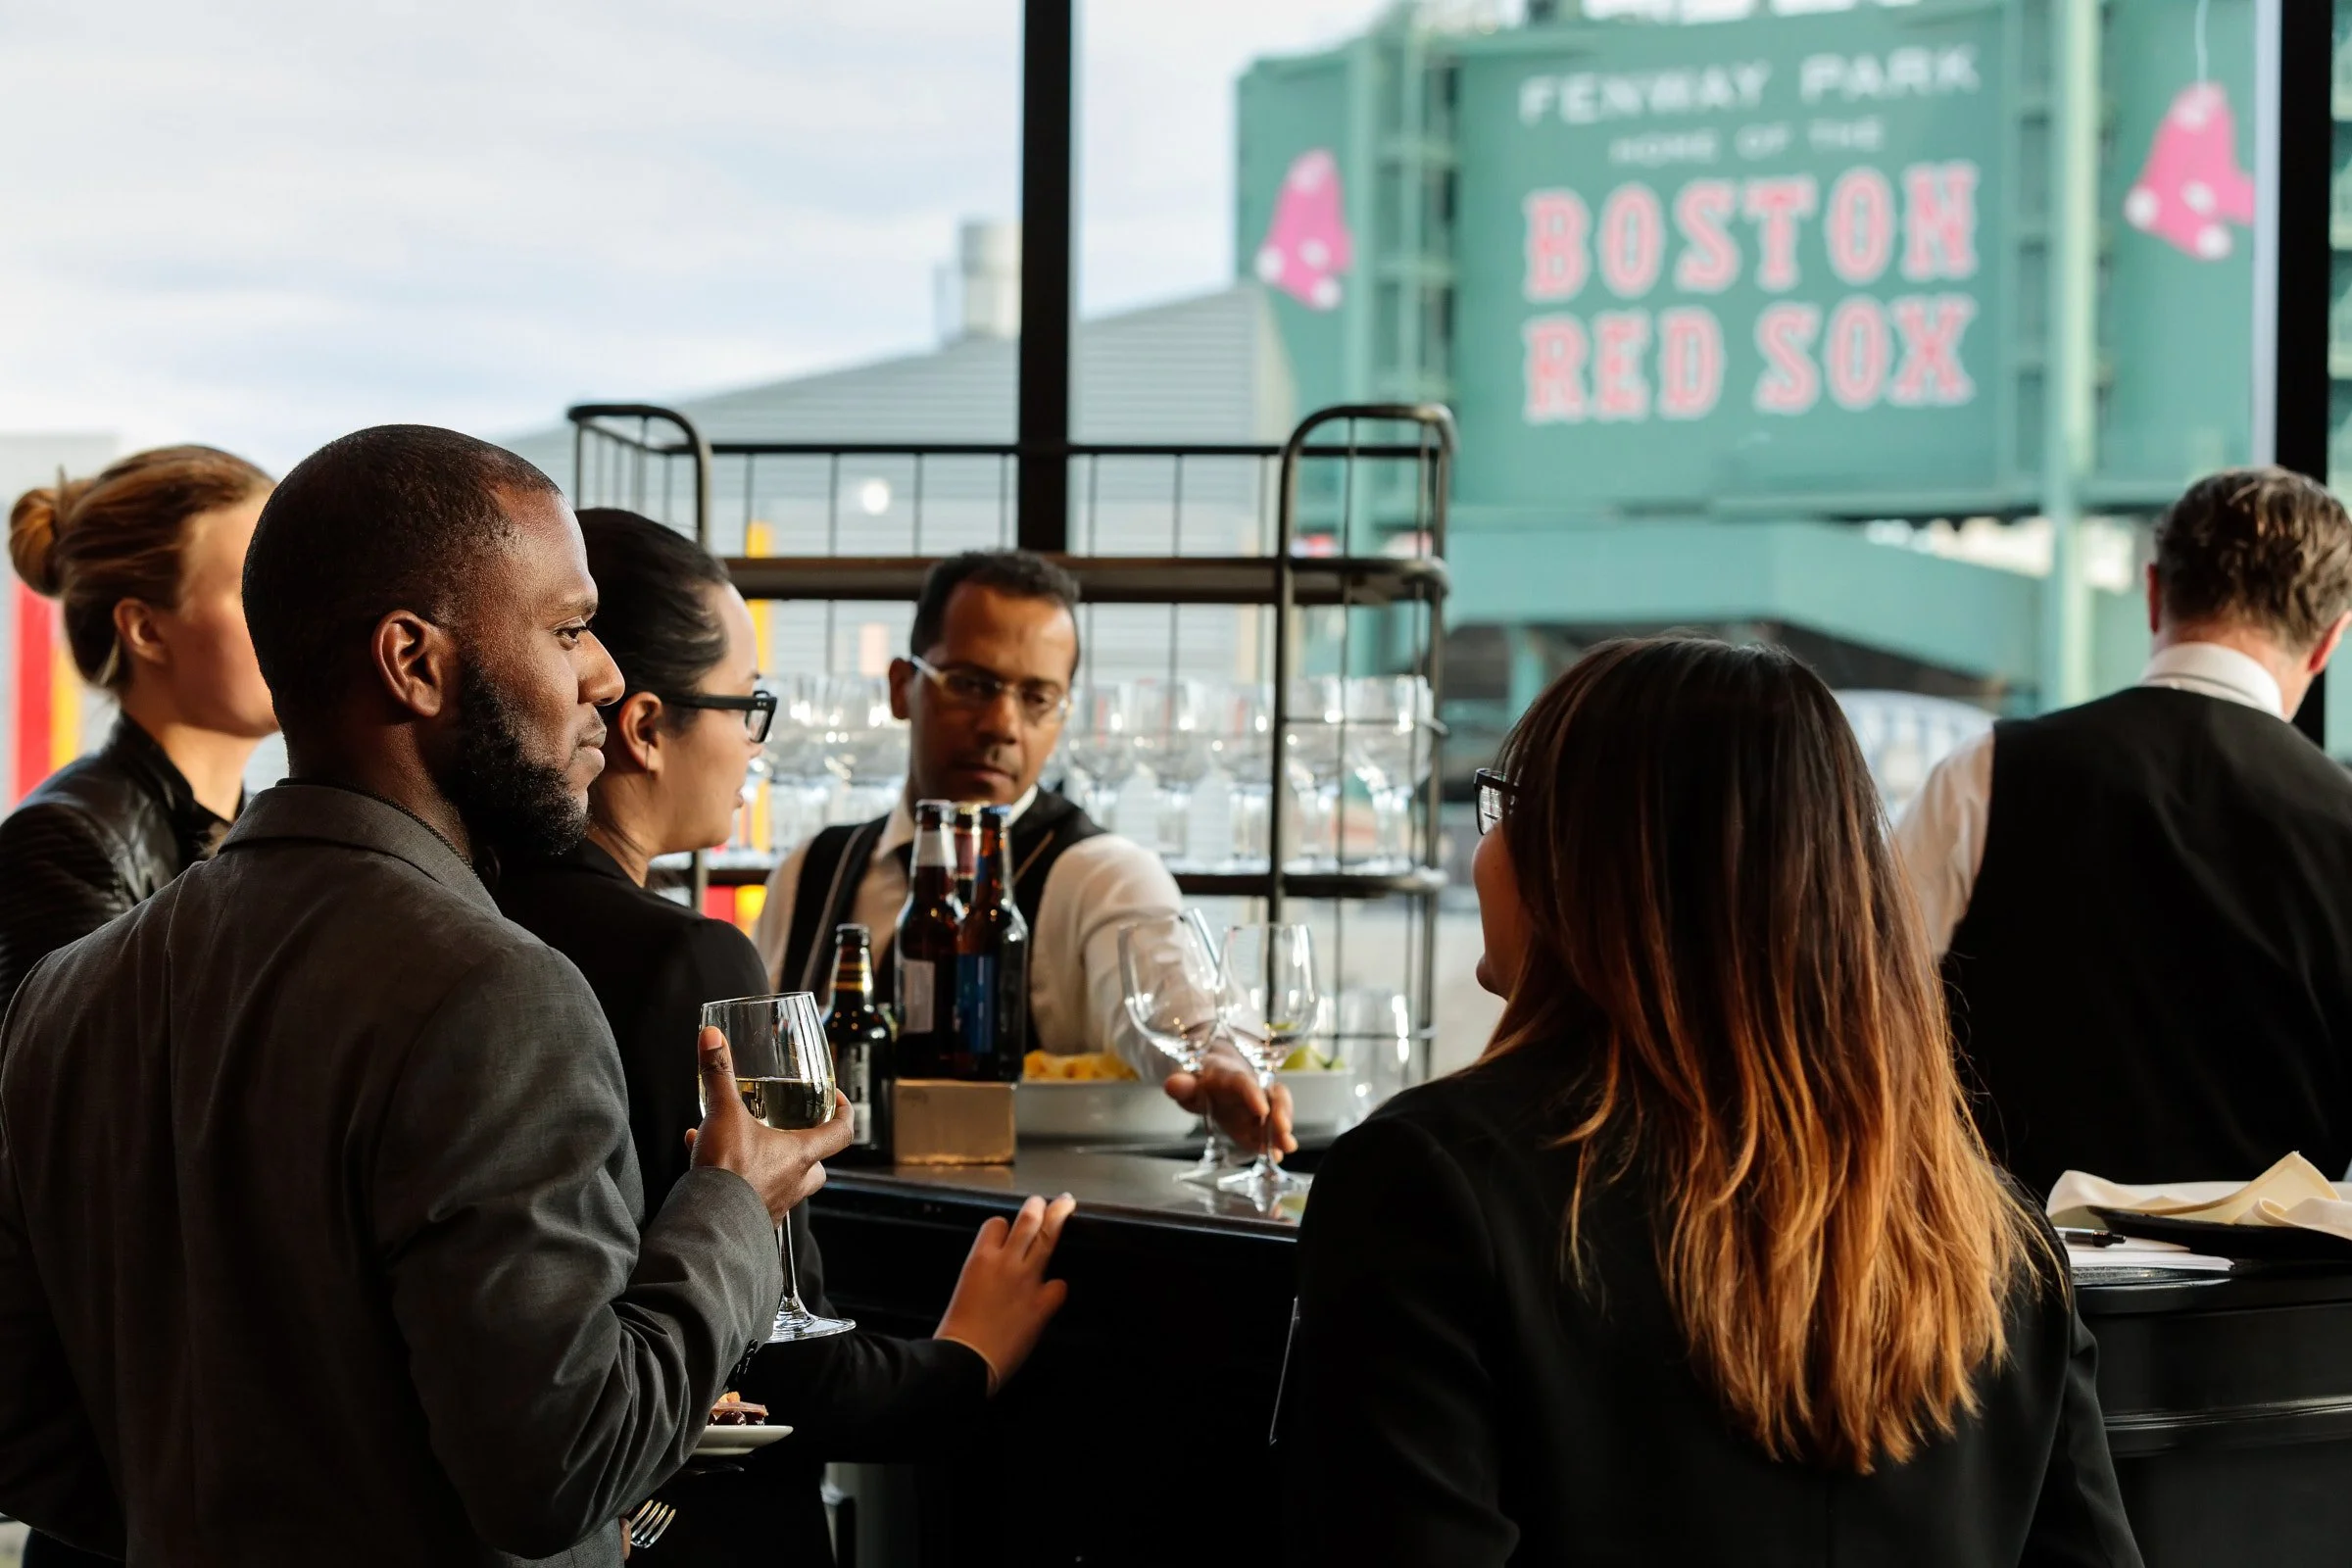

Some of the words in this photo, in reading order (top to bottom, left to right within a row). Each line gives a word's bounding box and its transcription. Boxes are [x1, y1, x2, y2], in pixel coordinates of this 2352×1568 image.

[1519, 62, 1769, 125] FENWAY
[1800, 44, 1980, 103] PARK
[1522, 159, 1979, 303] BOSTON
[1521, 306, 1726, 425] RED
[1752, 292, 1978, 416] SOX
